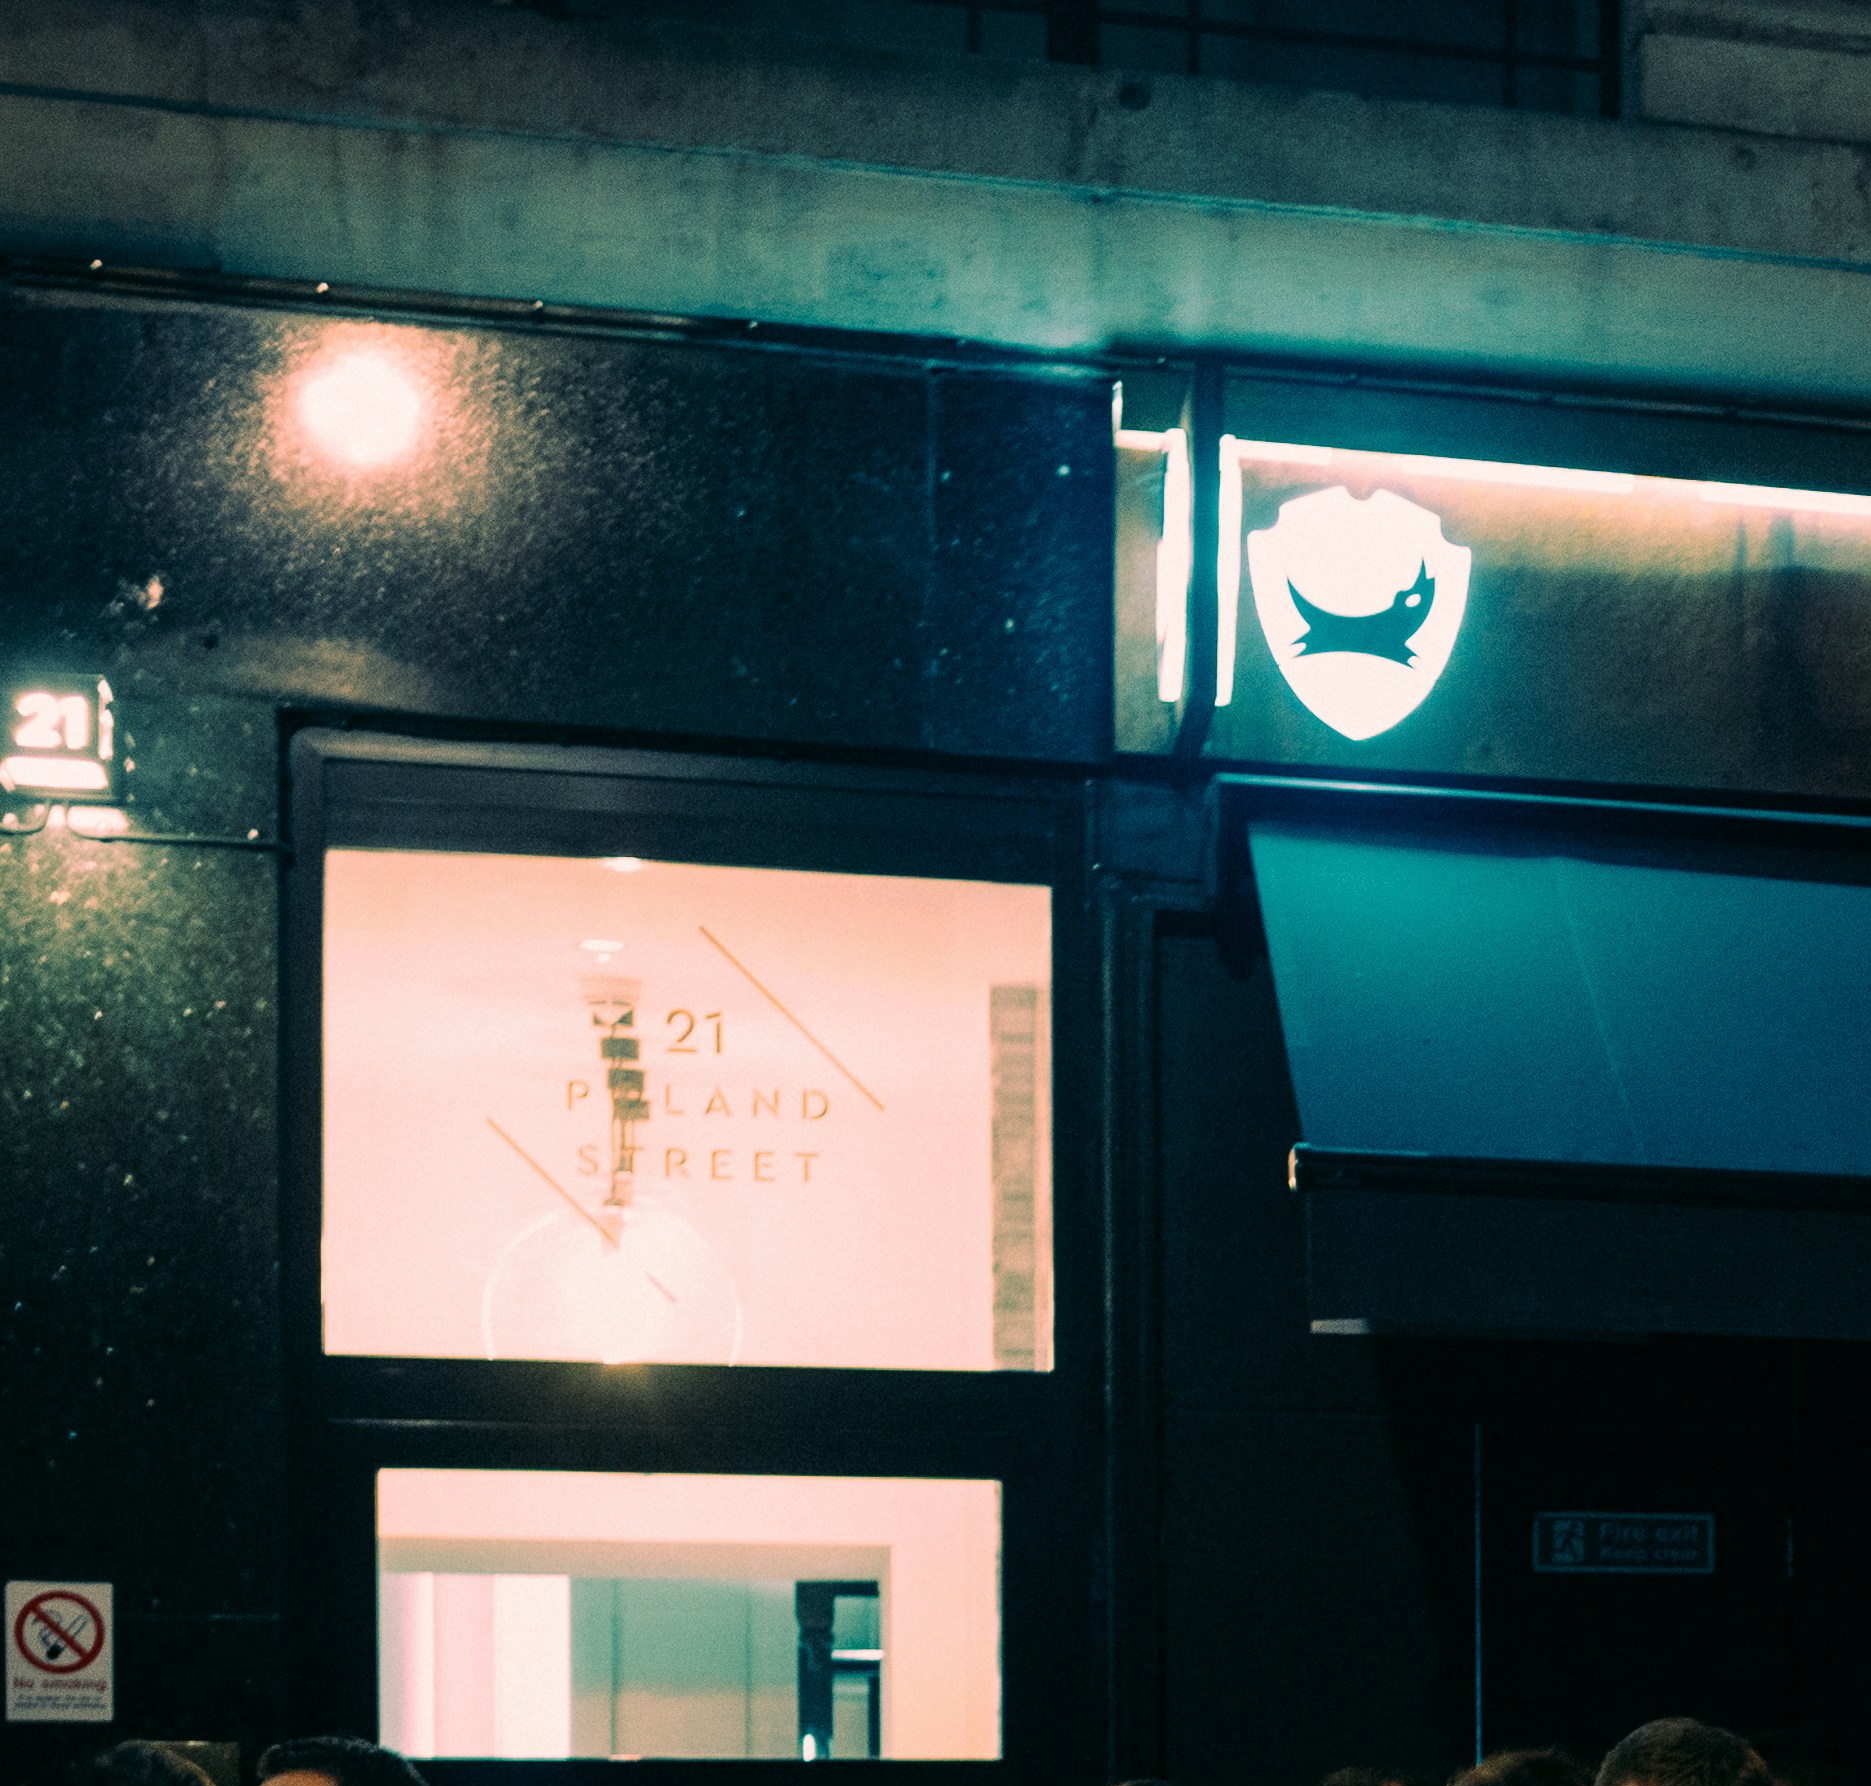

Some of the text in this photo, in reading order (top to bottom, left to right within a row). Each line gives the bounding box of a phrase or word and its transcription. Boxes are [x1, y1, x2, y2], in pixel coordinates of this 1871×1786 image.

[16, 691, 88, 750] 21
[665, 1008, 723, 1053] 21
[566, 1079, 830, 1120] PLAND
[576, 1143, 819, 1182] STREET
